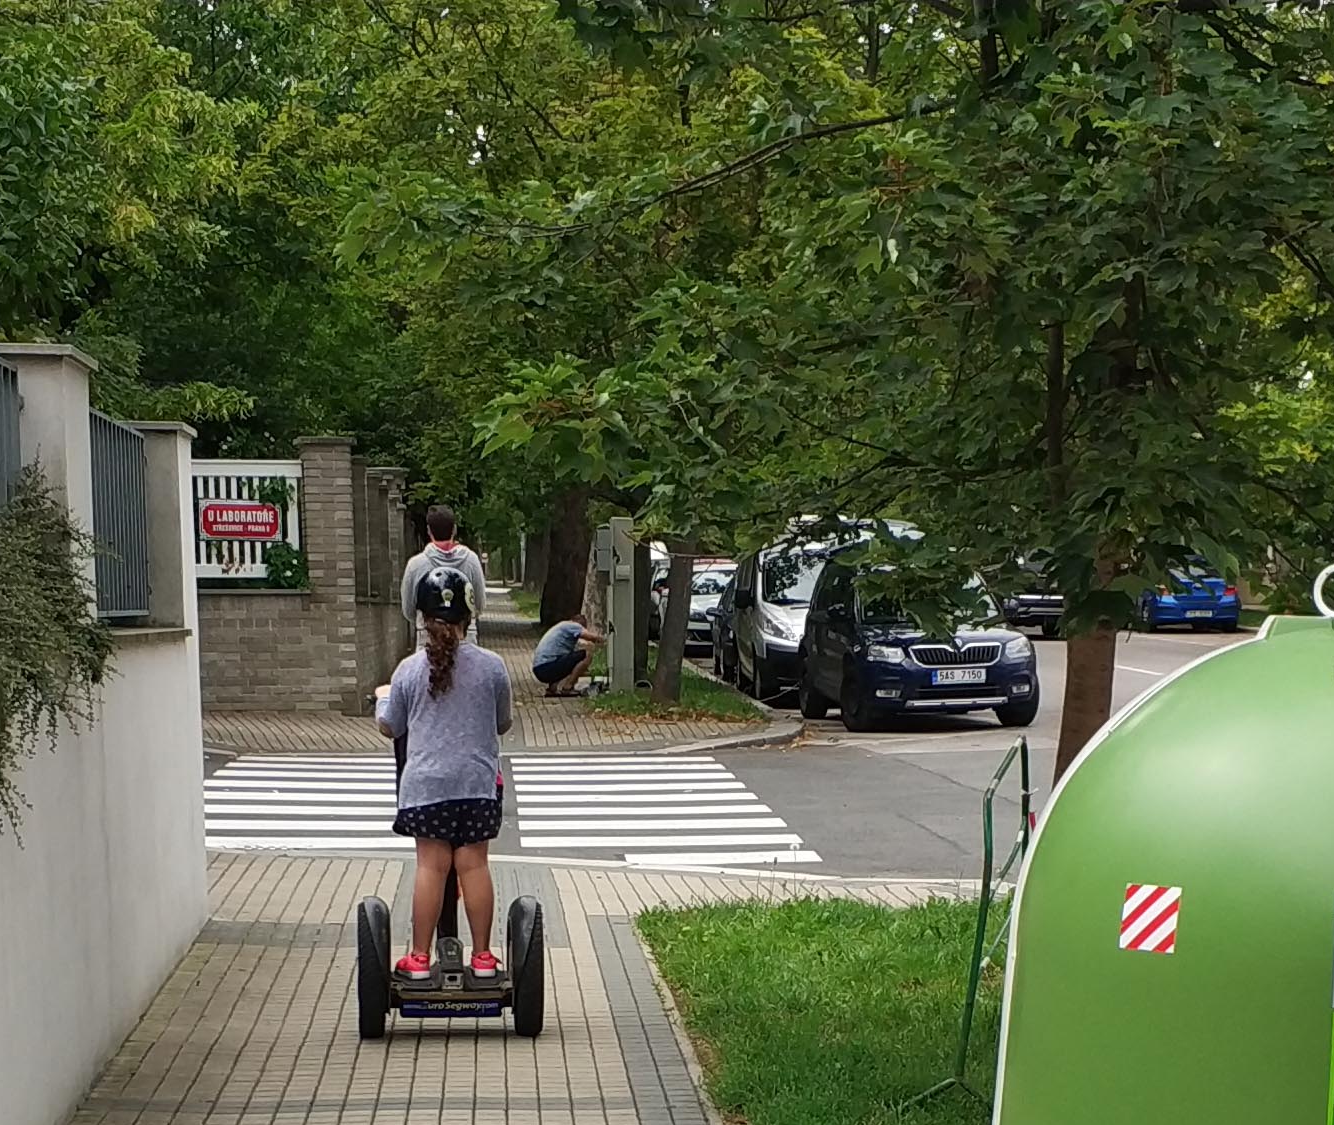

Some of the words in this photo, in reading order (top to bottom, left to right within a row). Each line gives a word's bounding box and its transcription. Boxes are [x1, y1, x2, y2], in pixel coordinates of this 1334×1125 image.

[208, 510, 214, 522] U
[216, 509, 274, 523] LABORATOŘE
[939, 671, 955, 681] 5AS
[961, 670, 982, 680] 7150
